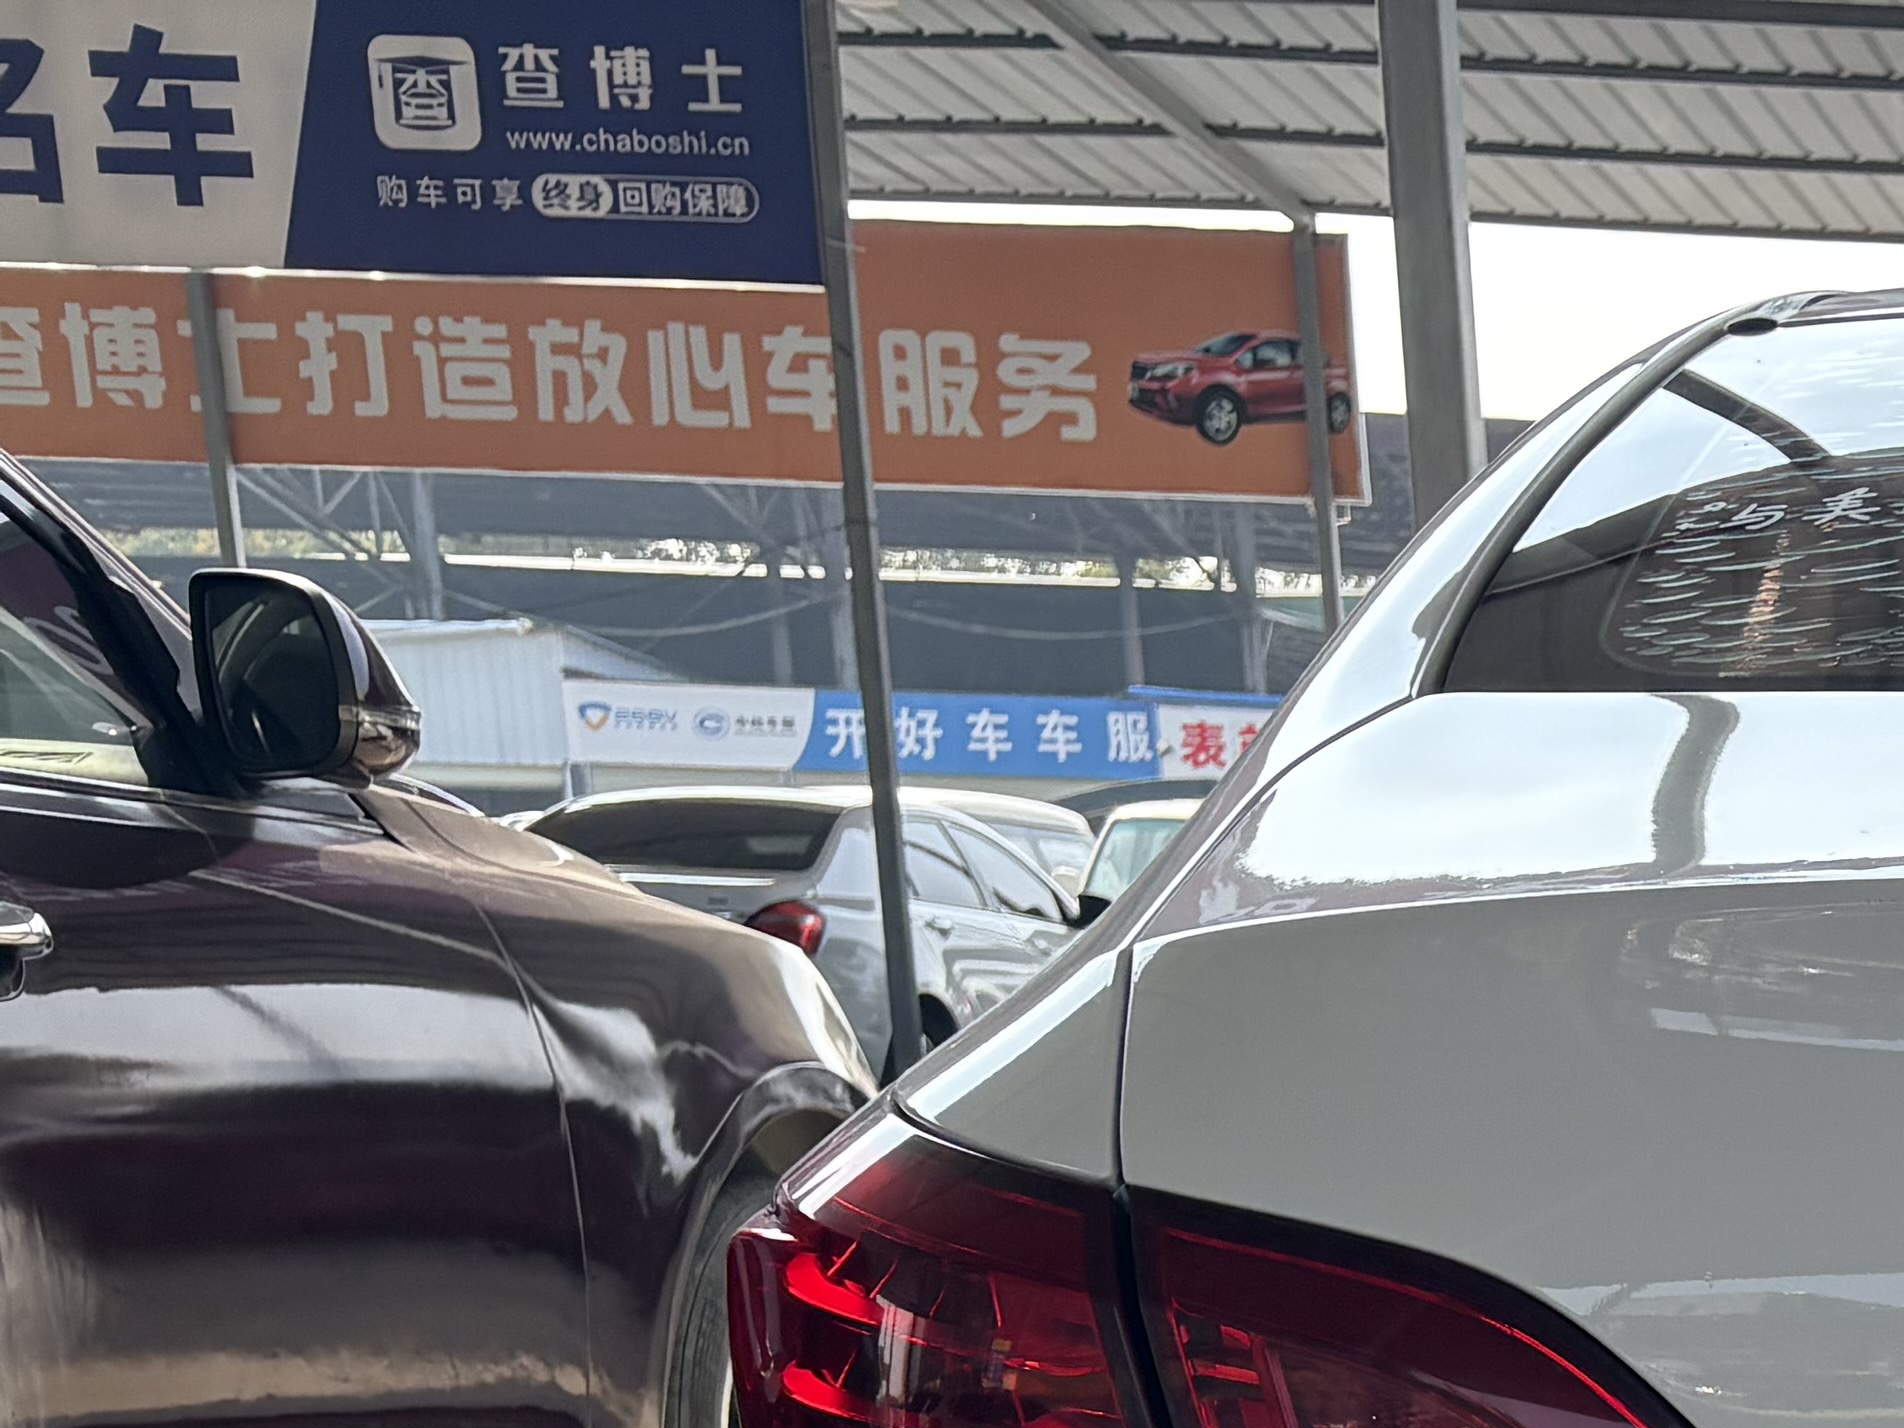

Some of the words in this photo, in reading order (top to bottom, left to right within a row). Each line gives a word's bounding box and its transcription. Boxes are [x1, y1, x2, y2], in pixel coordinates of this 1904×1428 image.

[498, 43, 743, 113] 查博士
[506, 128, 750, 156] www.chaboshi.cn
